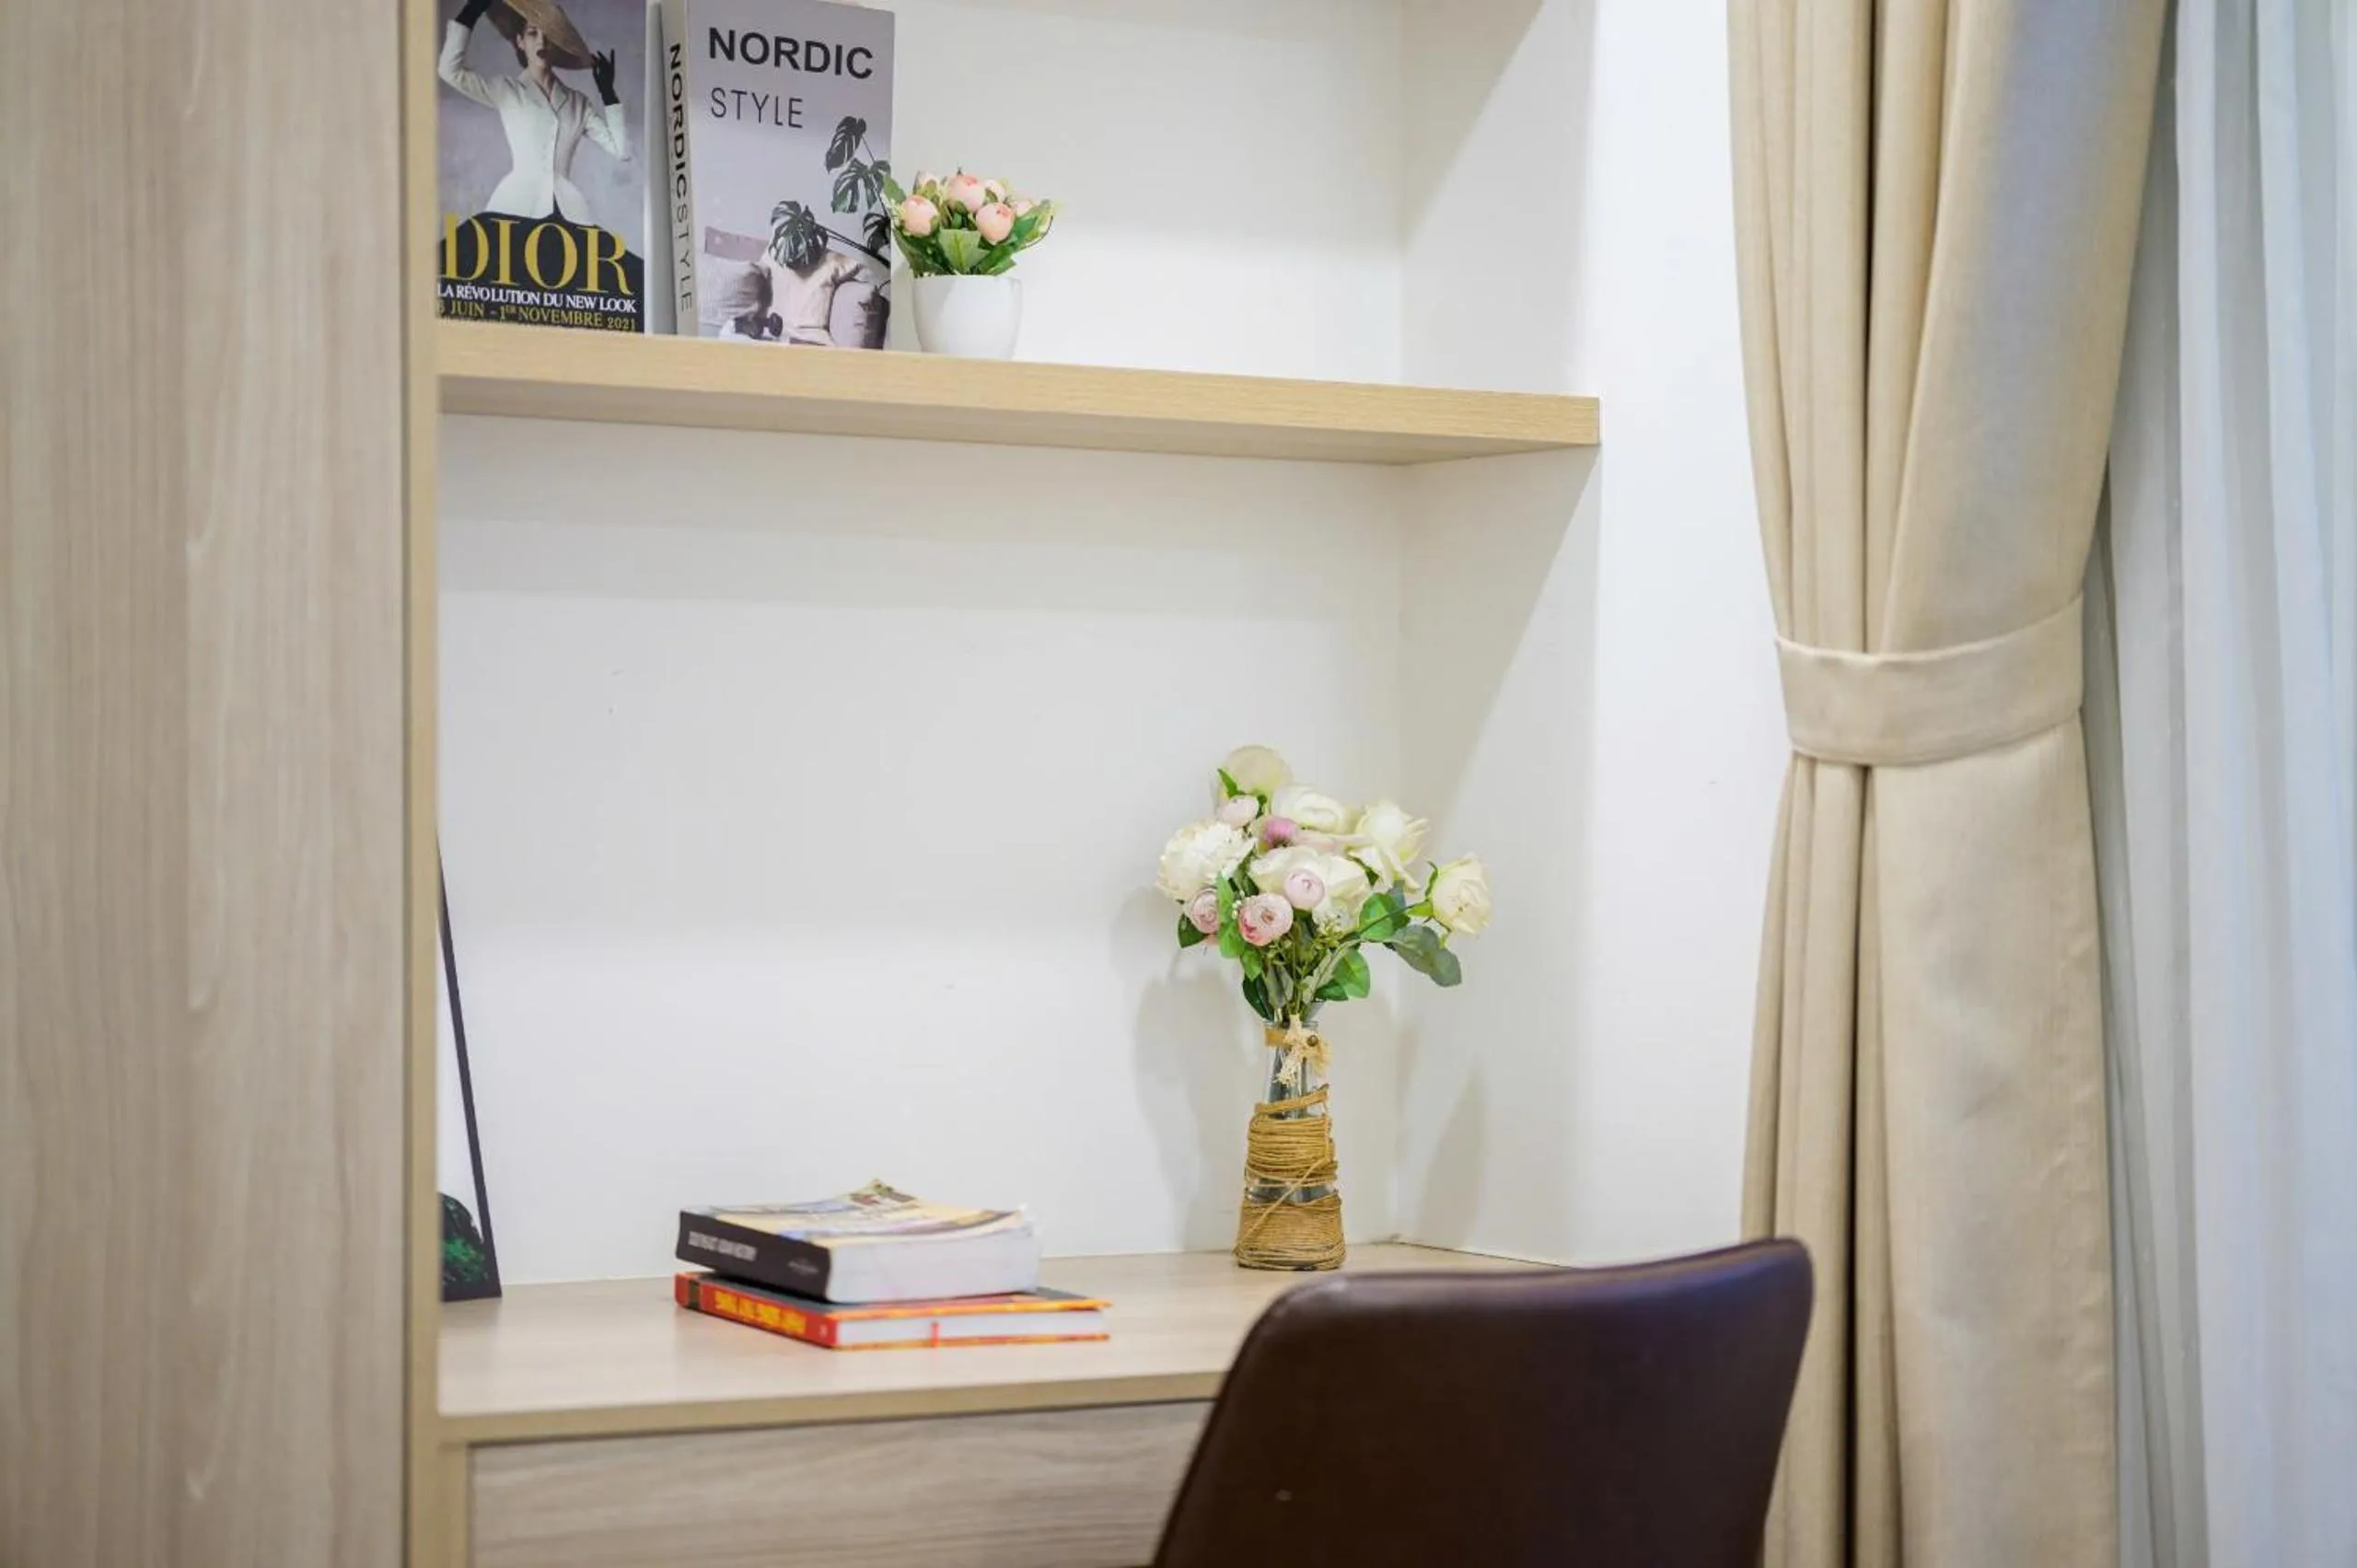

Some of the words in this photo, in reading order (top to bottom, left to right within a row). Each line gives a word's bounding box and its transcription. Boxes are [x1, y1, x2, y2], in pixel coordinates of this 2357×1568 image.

[709, 26, 874, 79] NORDIC
[669, 42, 689, 200] NORDIC
[710, 87, 804, 129] STYLE
[439, 213, 634, 296] DIOR
[676, 203, 692, 312] STYLE
[437, 283, 454, 298] LA
[456, 282, 540, 305] RÉVOLUTION
[543, 292, 563, 308] DU
[566, 295, 597, 310] NEW
[599, 296, 636, 313] LOOK
[450, 301, 485, 318] JUIN
[518, 306, 603, 327] NOVEMBRE
[607, 316, 635, 331] 2021
